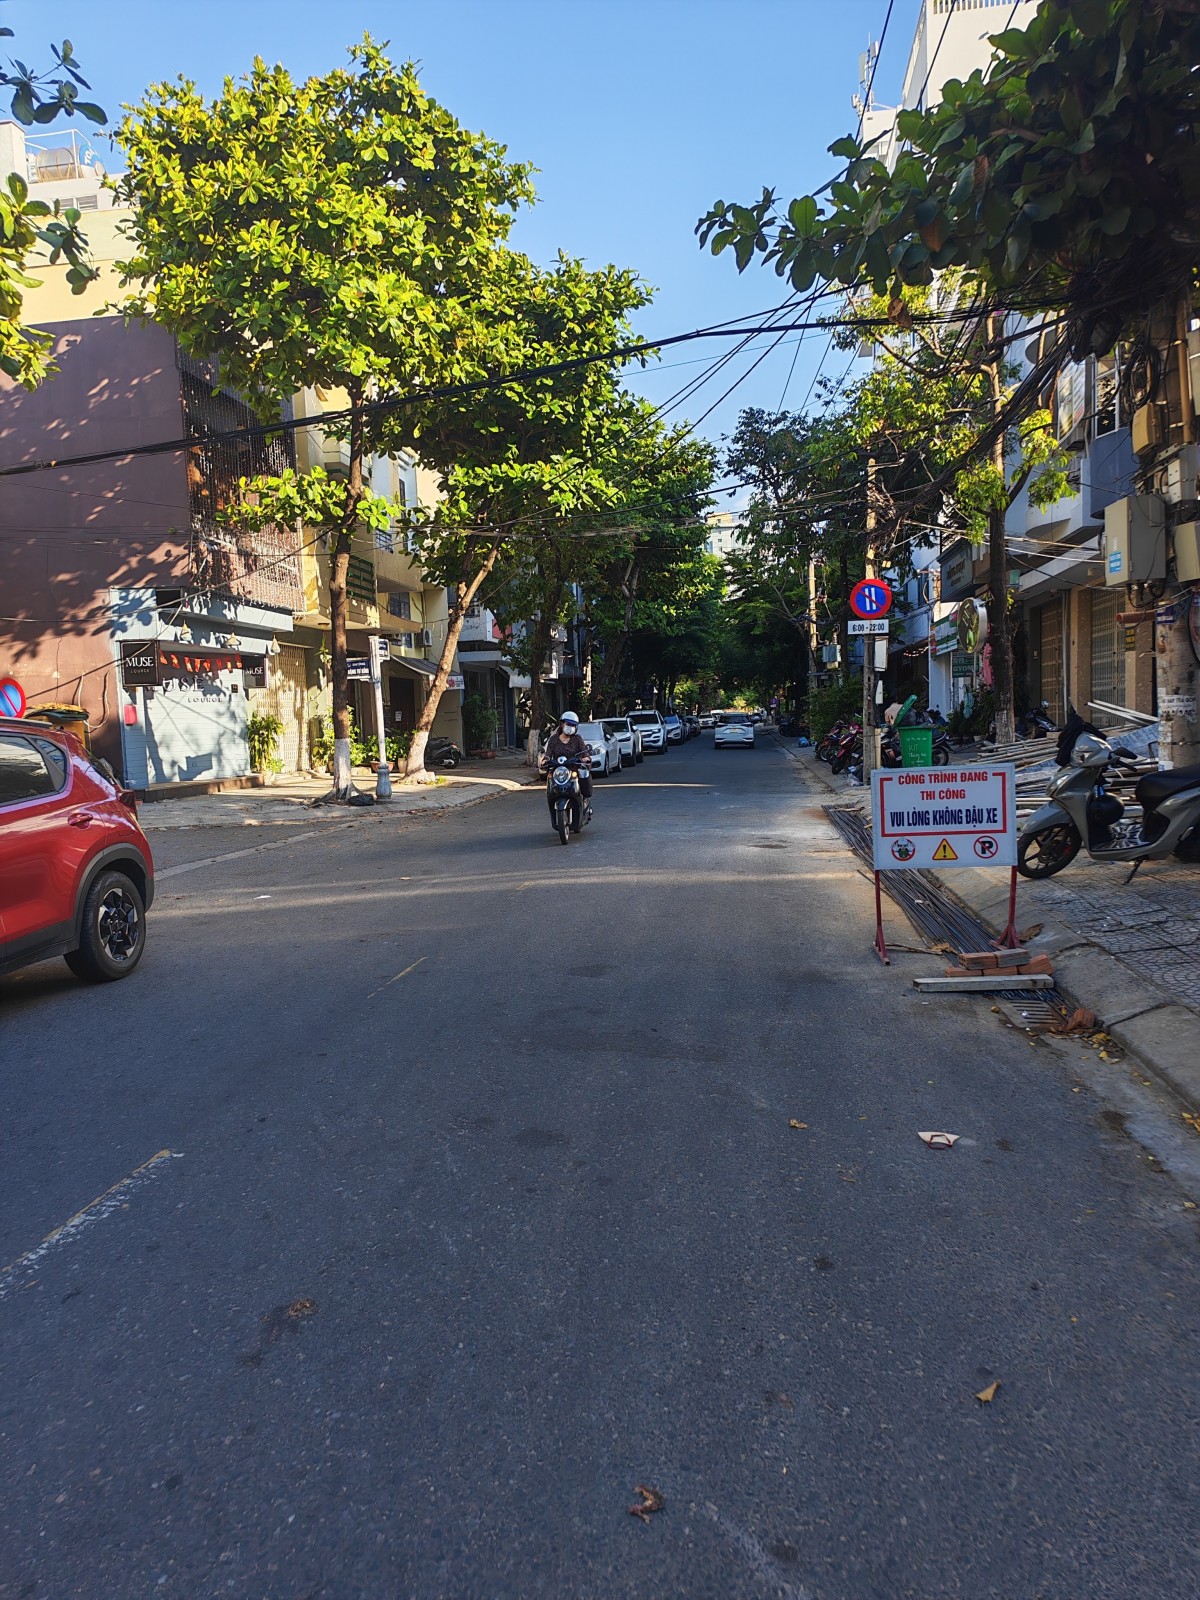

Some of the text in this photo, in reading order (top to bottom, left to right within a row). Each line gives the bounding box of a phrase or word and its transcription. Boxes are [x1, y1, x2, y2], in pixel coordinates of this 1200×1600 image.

[852, 624, 865, 632] 6:00
[869, 622, 885, 632] 22:00
[125, 656, 154, 667] MUSE
[245, 666, 264, 675] MUSE
[898, 771, 988, 785] CÔNG TRÌNH ĐANG
[920, 788, 966, 800] THI CÔNG
[890, 805, 997, 828] VUI LÒNG KHÔNG ĐẬU XE
